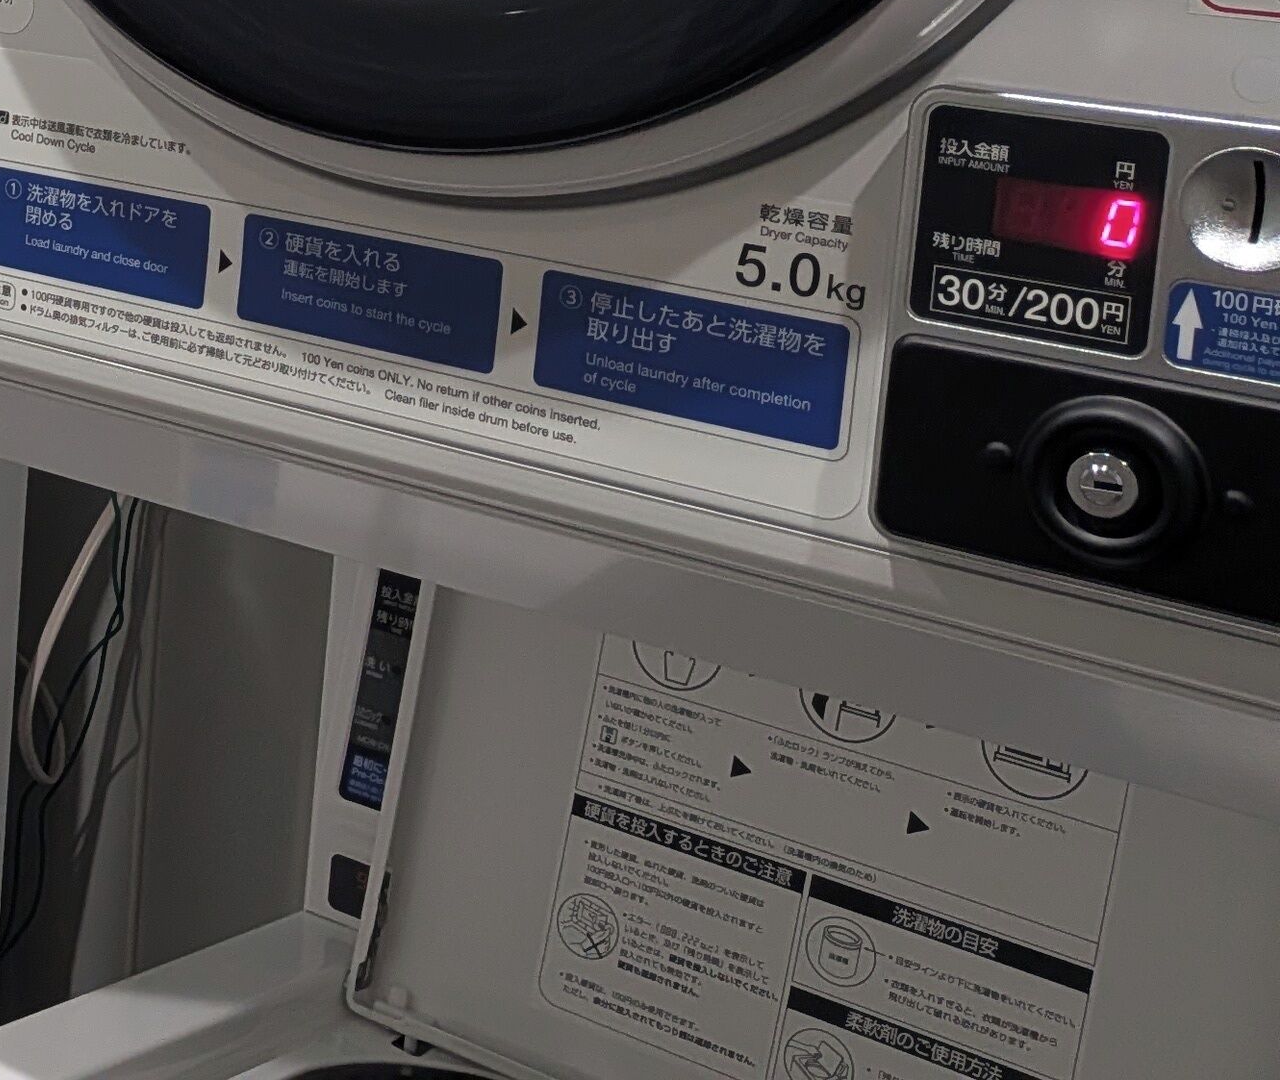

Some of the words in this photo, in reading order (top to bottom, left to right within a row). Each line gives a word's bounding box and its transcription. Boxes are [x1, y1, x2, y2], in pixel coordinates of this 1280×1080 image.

[11, 130, 34, 143] Cool
[36, 134, 65, 149] Down
[67, 139, 96, 154] Cycle
[939, 137, 1010, 163] 投入金額
[938, 156, 966, 170] INPUT
[968, 159, 1010, 174] AMOUNT
[1115, 161, 1136, 181] 円
[1113, 180, 1134, 191] YEN
[25, 207, 73, 232] 閉める
[26, 182, 178, 229] 洗濯物を入れドアを
[760, 203, 853, 237] 乾燥容量
[760, 226, 792, 243] Dryer
[795, 231, 849, 253] Capacity
[1099, 198, 1142, 249] 0
[25, 234, 50, 249] Load
[52, 240, 89, 261] laundry
[90, 248, 111, 264] and
[113, 254, 141, 269] close
[143, 260, 169, 274] door
[284, 232, 401, 272] 硬貨を入れる
[932, 231, 1002, 258] 残り時間
[951, 252, 975, 264] TIME
[283, 258, 408, 298] 運転を開始します
[1106, 260, 1127, 278] 分
[280, 288, 313, 306] Insert
[315, 297, 348, 313] coins
[350, 303, 363, 316] to
[365, 306, 394, 323] start
[395, 312, 416, 328] the
[418, 318, 452, 335] cycle
[590, 290, 827, 358] 停止したあと洗濯物を
[1222, 312, 1247, 326] 100
[1251, 316, 1277, 331] Yen
[586, 317, 677, 354] 取り出す
[1100, 323, 1122, 336] YEN
[301, 351, 321, 366] 100
[323, 355, 344, 371] Yen
[346, 363, 375, 379] coins
[377, 369, 414, 389] ONLY.
[417, 378, 433, 394] No
[435, 384, 470, 401] return
[471, 389, 480, 403] if
[482, 393, 513, 410] other
[515, 402, 547, 418] coins
[549, 408, 601, 431] inserted.
[583, 371, 598, 386] of
[600, 376, 637, 394] cycle
[585, 352, 634, 375] Unload
[637, 361, 690, 388] laundry
[692, 374, 726, 393] after
[728, 384, 811, 412] completion
[384, 389, 416, 406] Clean
[442, 401, 476, 420] inside
[478, 411, 508, 428] drum
[511, 419, 549, 437] before
[552, 429, 577, 445] use.
[584, 799, 793, 887] 硬貨を投入するときのご注意
[891, 905, 999, 958] 洗濯物の目安
